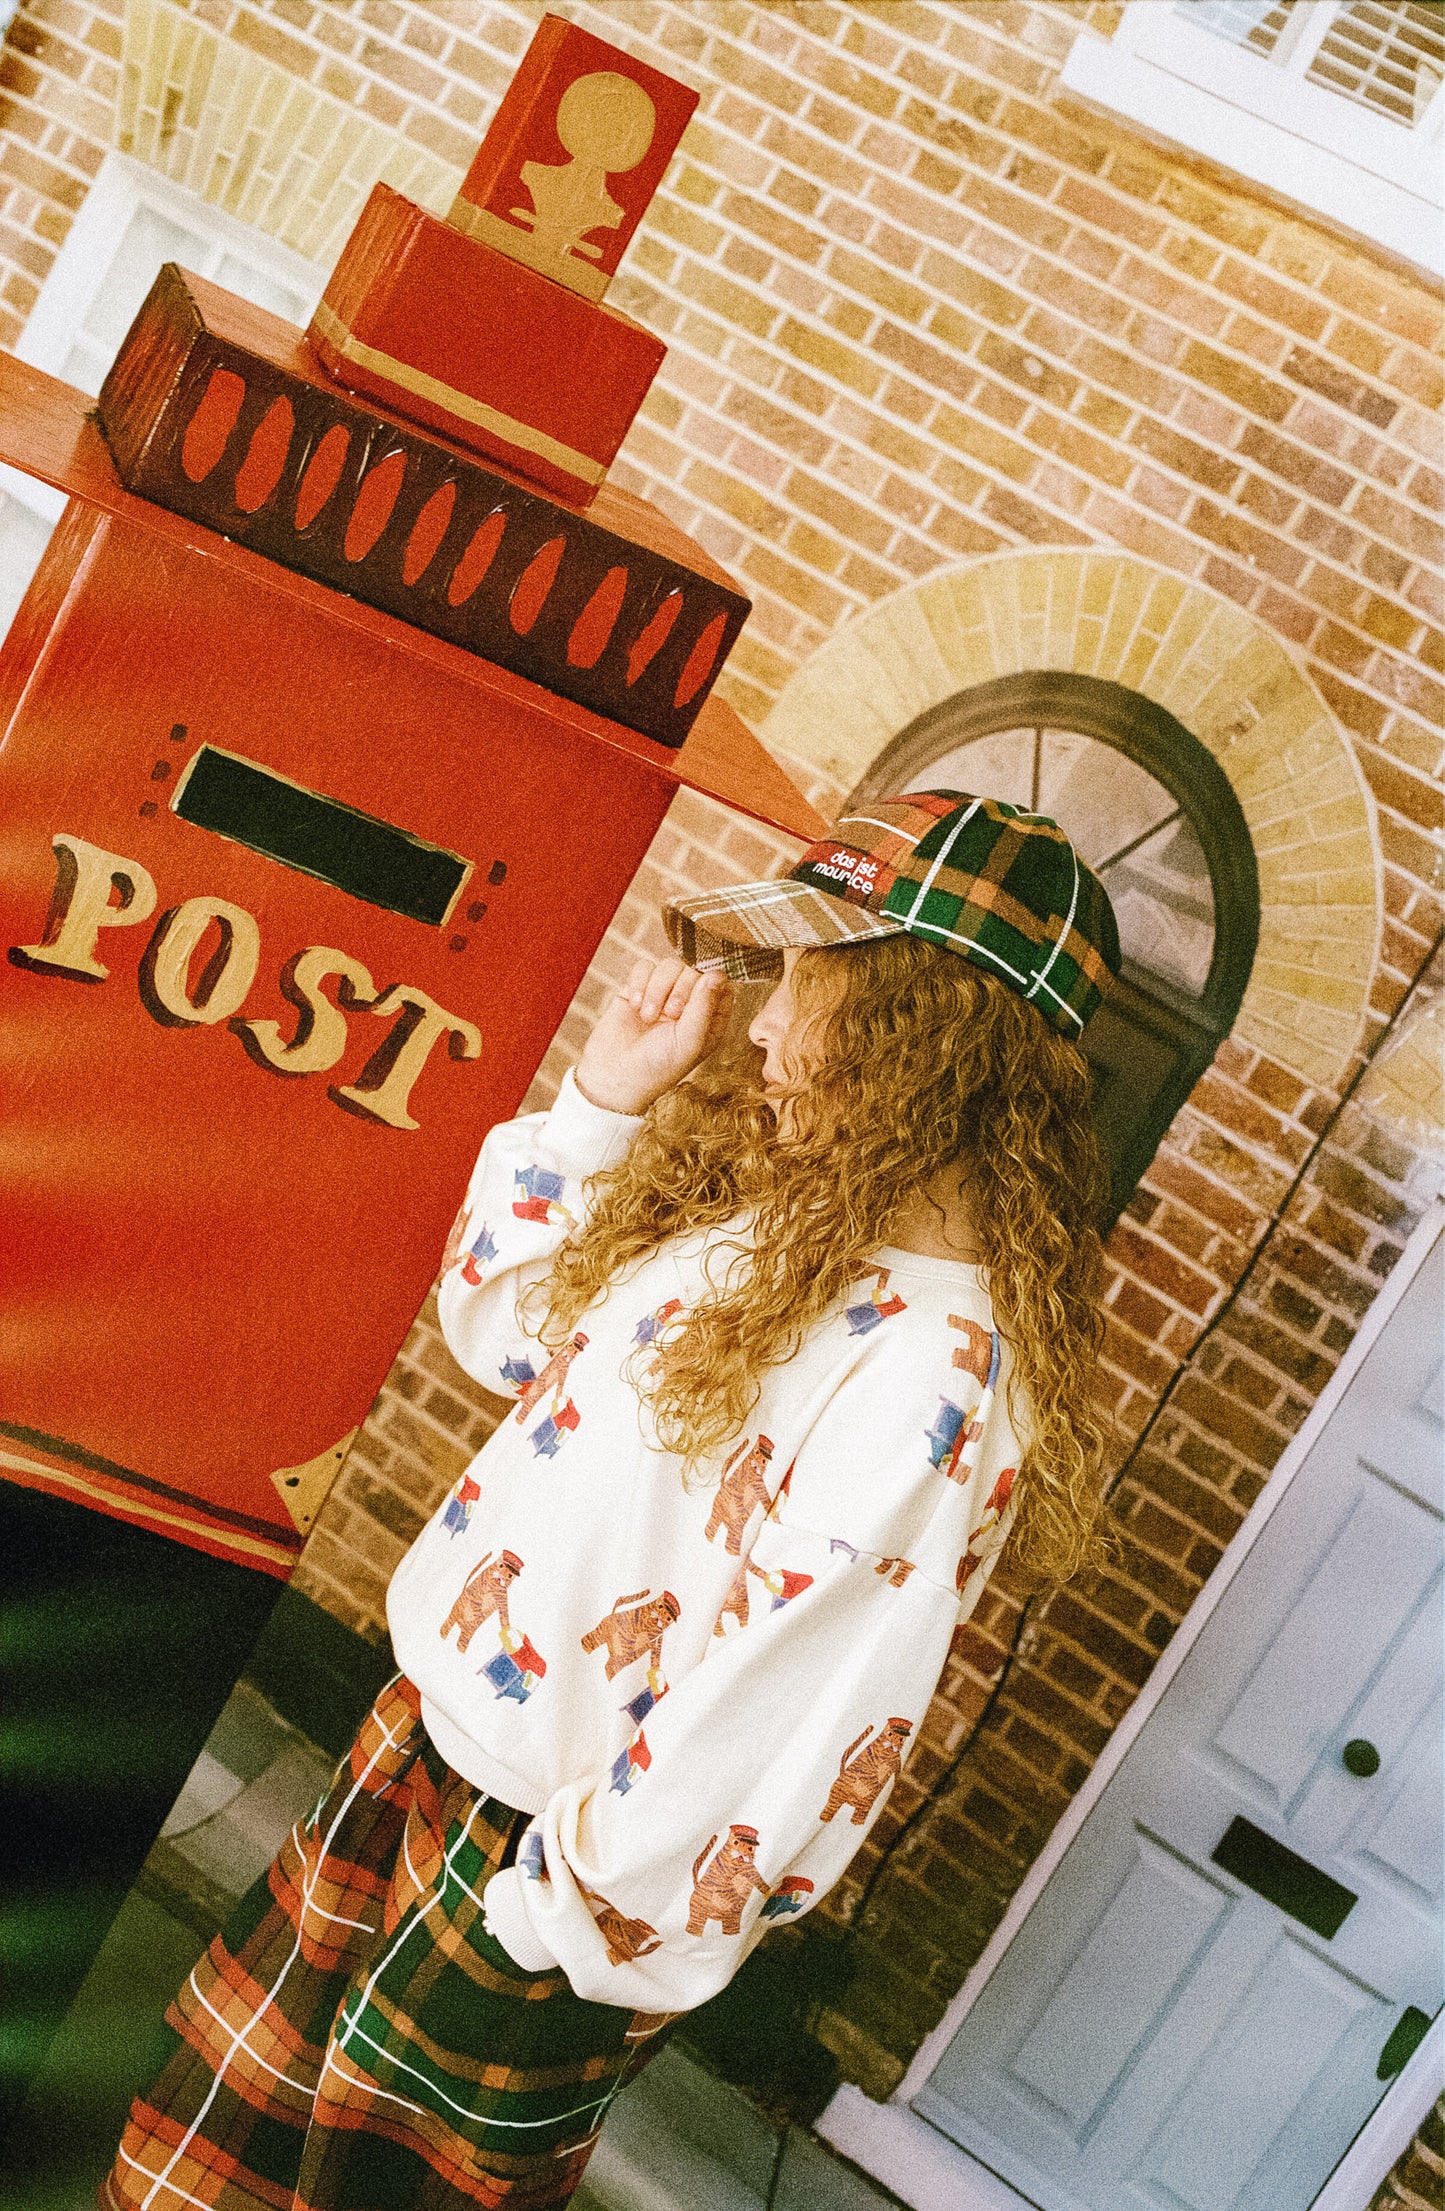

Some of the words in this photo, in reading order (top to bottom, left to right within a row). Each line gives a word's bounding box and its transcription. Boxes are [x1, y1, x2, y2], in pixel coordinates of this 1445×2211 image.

[812, 862, 874, 895] maurice
[830, 850, 857, 869] das
[857, 857, 878, 879] ist
[9, 832, 482, 1130] POST
